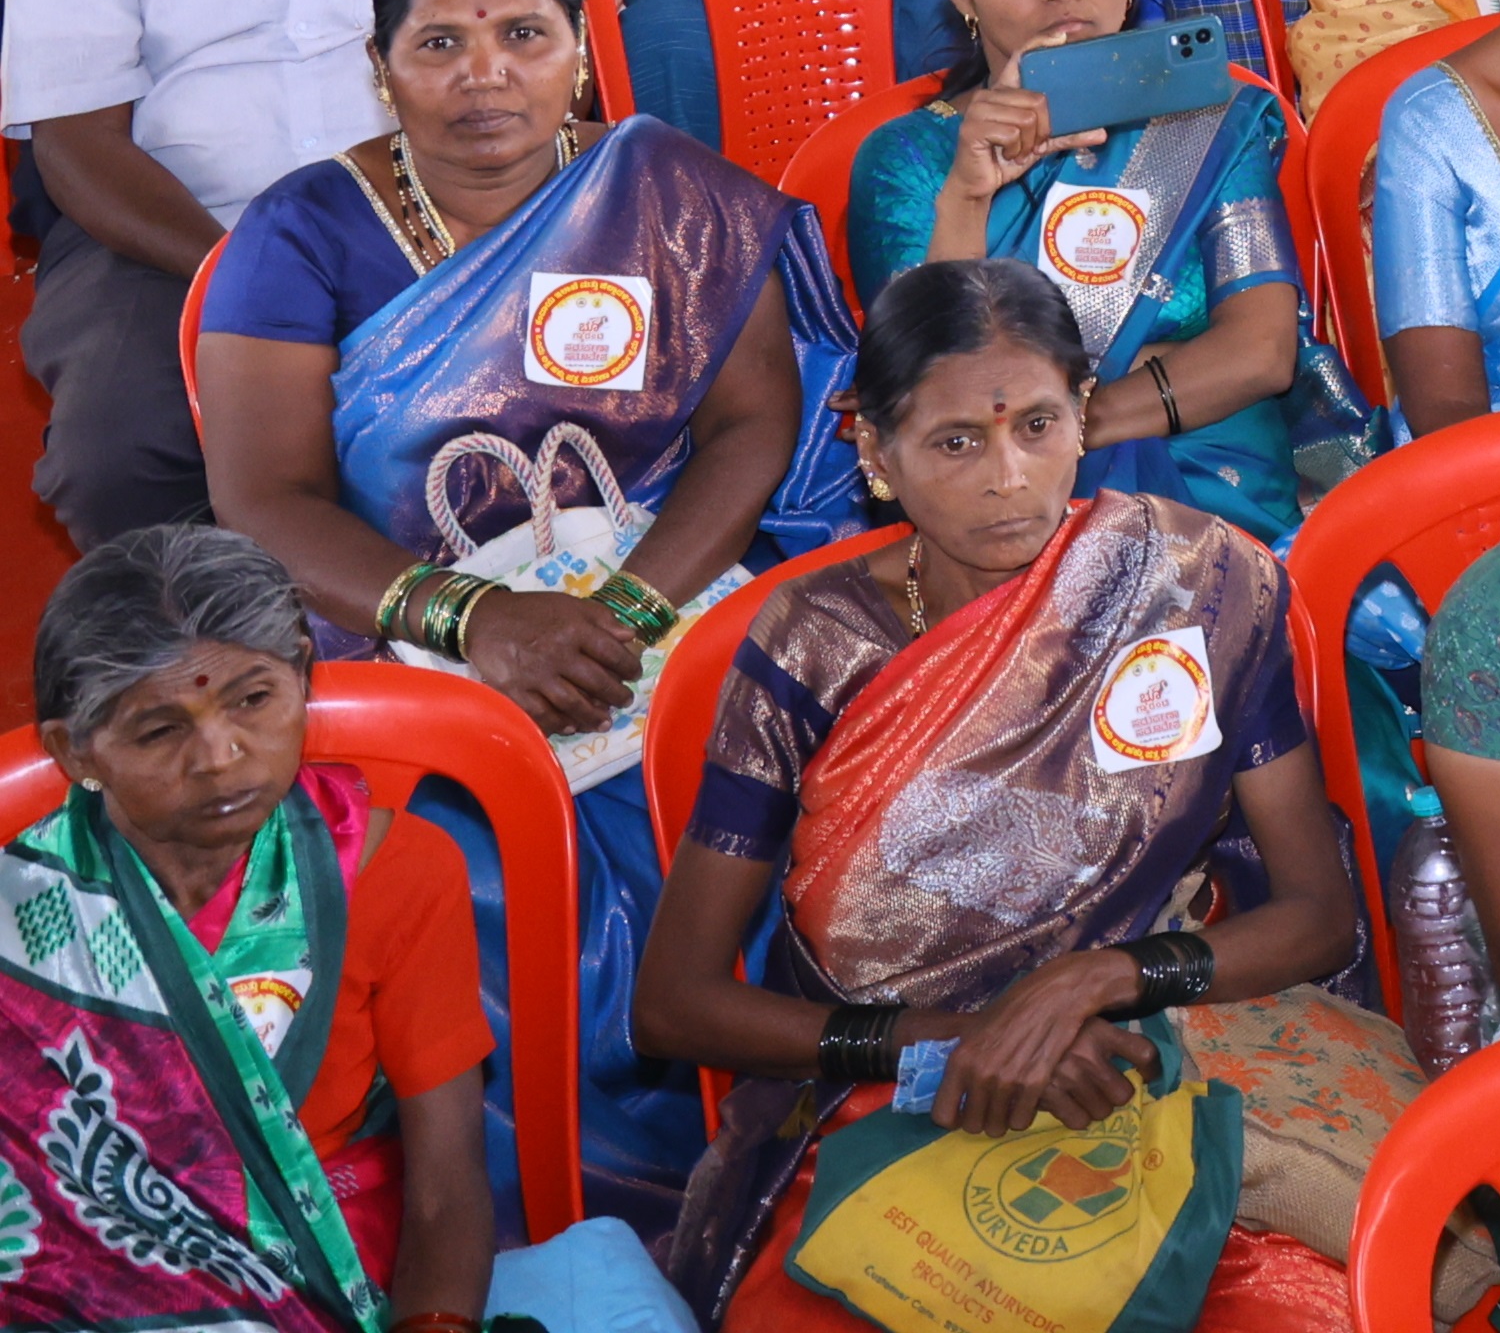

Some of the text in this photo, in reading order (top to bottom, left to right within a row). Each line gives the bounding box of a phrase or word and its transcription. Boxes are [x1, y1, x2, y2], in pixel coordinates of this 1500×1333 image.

[970, 1184, 1070, 1257] AYURVEDA
[883, 1205, 1067, 1333] BEST QUALITY AYURVEDIC
[911, 1259, 995, 1325] PRODUCTS
